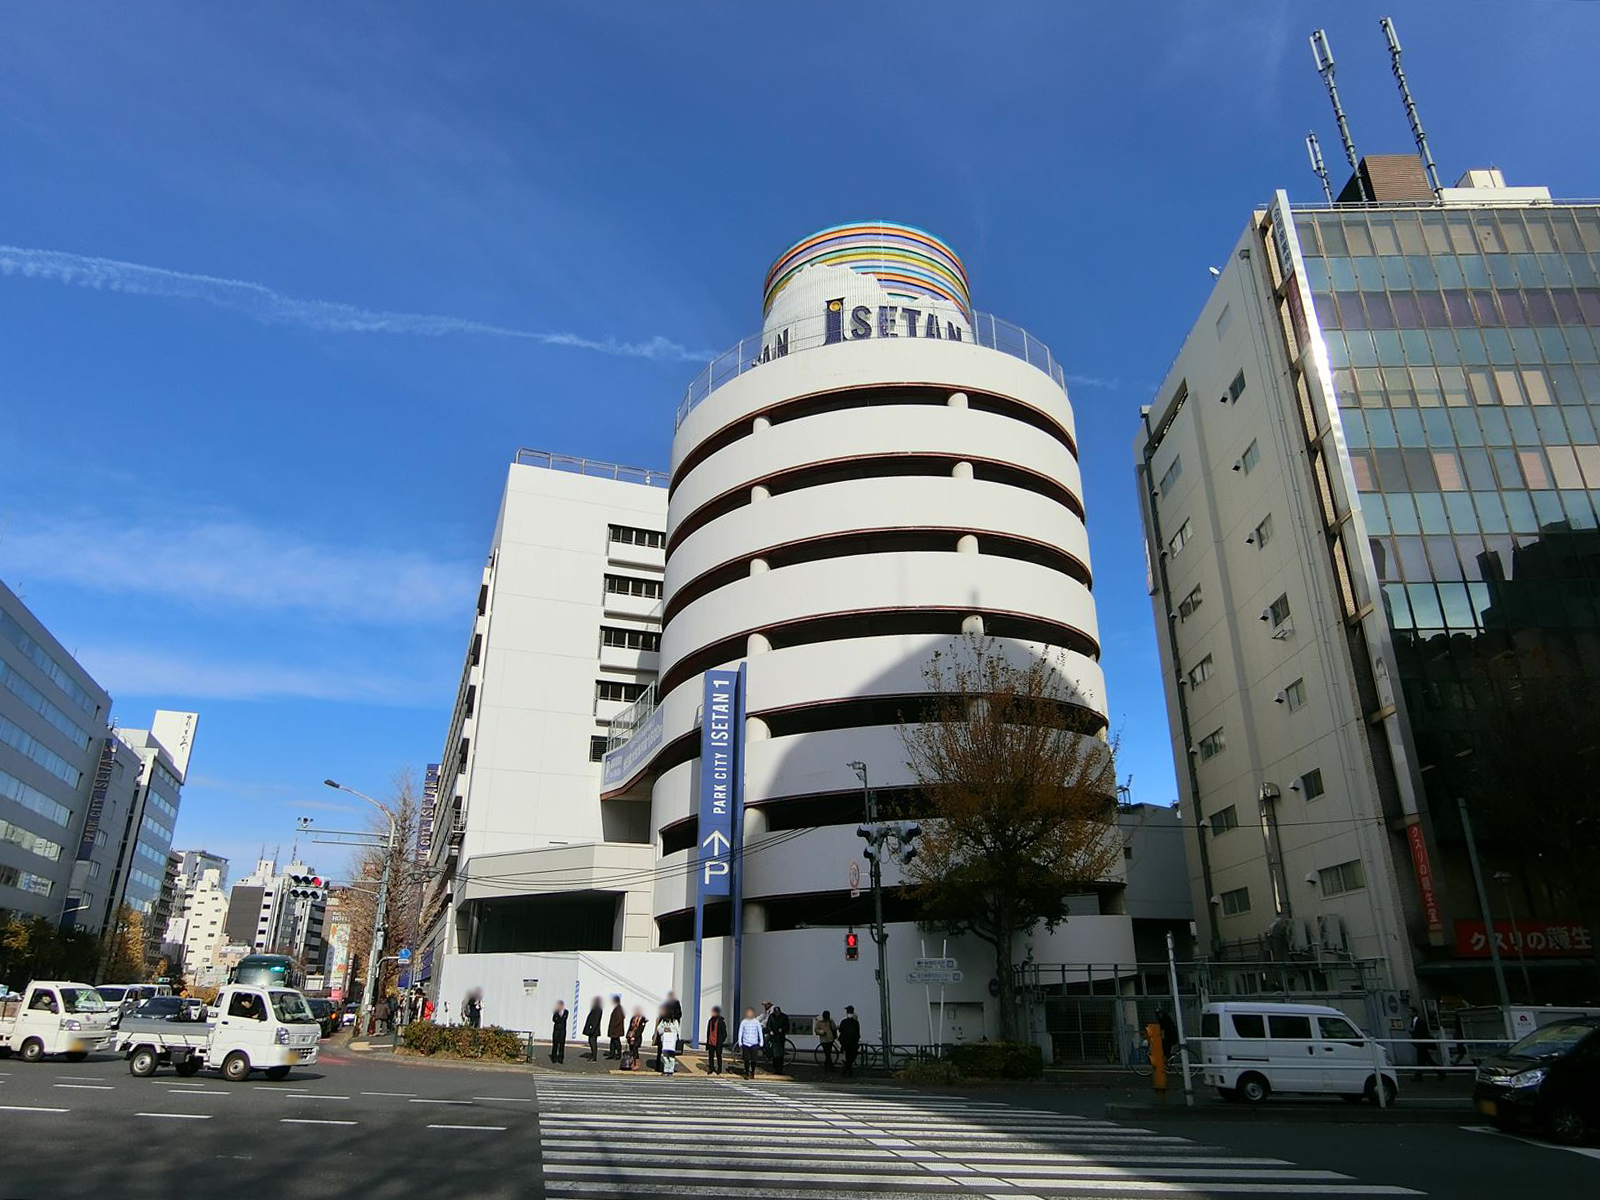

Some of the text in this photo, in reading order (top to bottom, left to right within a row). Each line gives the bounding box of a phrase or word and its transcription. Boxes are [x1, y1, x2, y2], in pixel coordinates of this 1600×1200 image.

[822, 296, 962, 347] ISETAN
[711, 693, 729, 745] ISETAN
[714, 752, 728, 779] CITY
[91, 798, 105, 820] CITY
[713, 781, 726, 814] PARK
[704, 862, 730, 884] P
